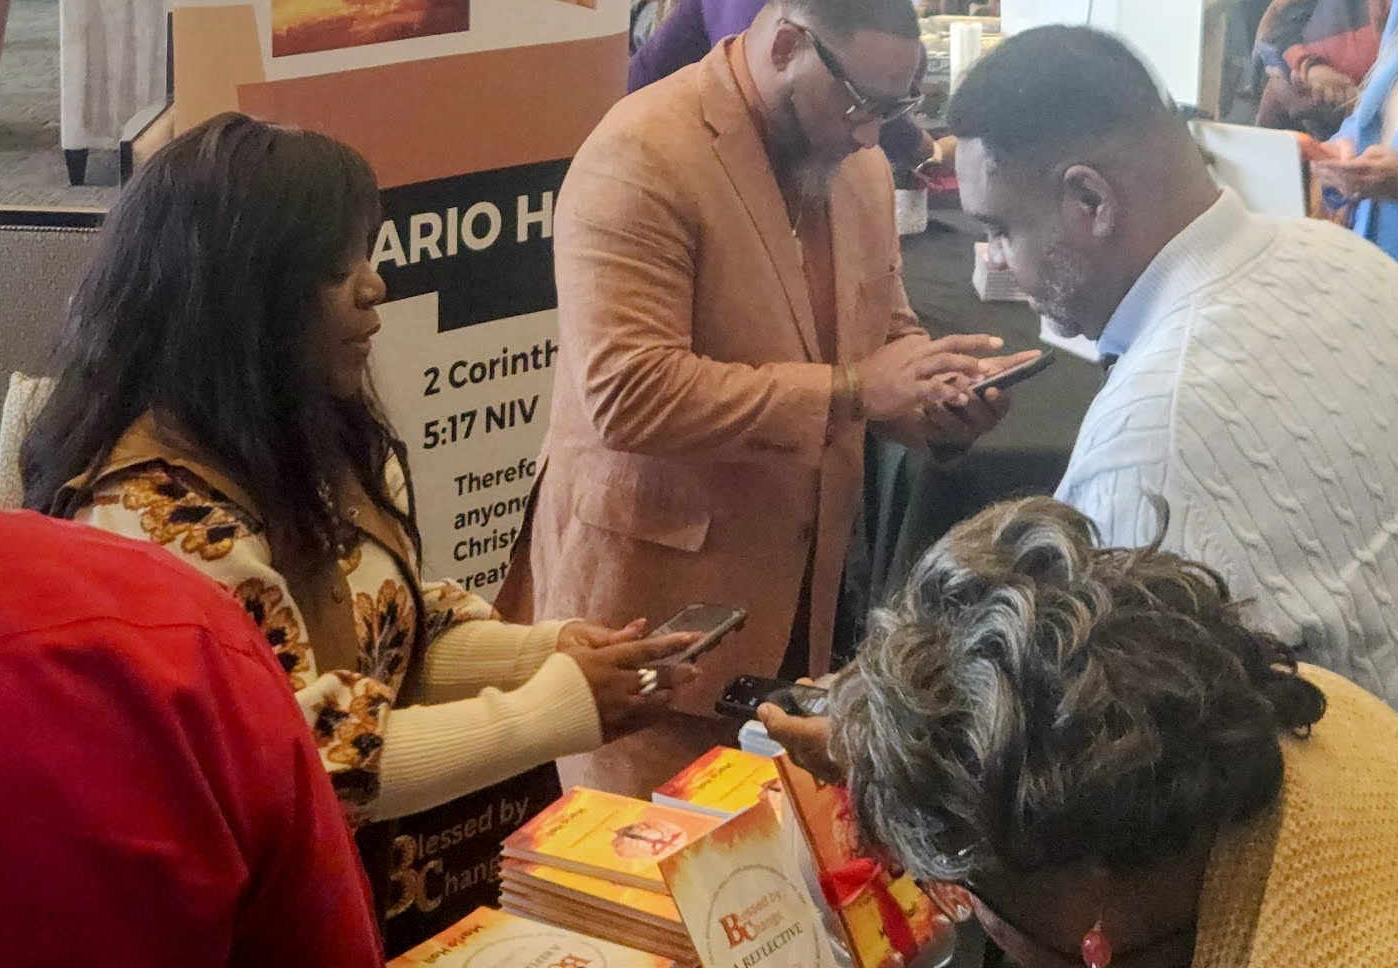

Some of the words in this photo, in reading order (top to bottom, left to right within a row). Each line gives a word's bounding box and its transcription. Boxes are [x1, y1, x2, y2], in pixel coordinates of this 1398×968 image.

[369, 201, 502, 273] ARIO
[423, 366, 441, 397] 2
[448, 339, 559, 389] Corinth
[423, 409, 478, 449] 5:17
[485, 394, 540, 433] NIV
[454, 457, 537, 496] Therefo
[455, 560, 509, 592] reat
[499, 796, 529, 825] by
[418, 854, 500, 913] Chang
[742, 921, 803, 968] REFLECTIVE
